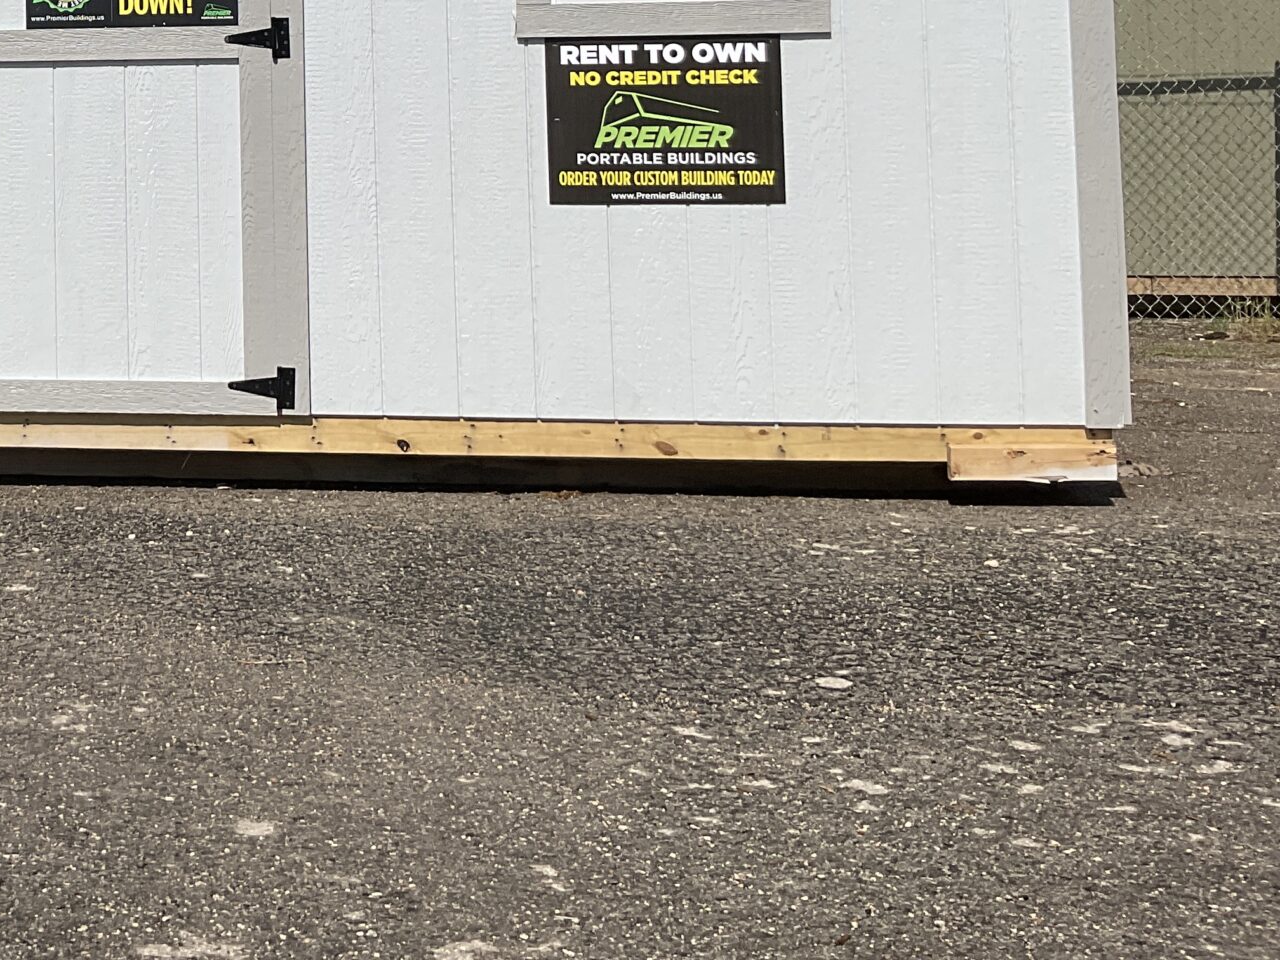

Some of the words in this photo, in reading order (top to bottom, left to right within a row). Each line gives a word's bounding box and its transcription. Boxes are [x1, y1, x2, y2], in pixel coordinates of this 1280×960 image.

[559, 44, 638, 65] RENT
[644, 43, 685, 63] TO
[691, 42, 766, 63] OWN
[570, 71, 601, 86] NO
[605, 70, 681, 86] CREDIT
[685, 69, 759, 84] CHECK
[593, 125, 734, 149] PREMIER
[576, 152, 663, 165] PORTABLE
[667, 152, 756, 164] BUILDINGS
[559, 171, 597, 186] ORDER
[600, 171, 630, 186] YOUR
[633, 171, 678, 186] CUSTOM
[681, 171, 735, 185] BUILDING
[738, 170, 775, 185] TODAY
[611, 192, 722, 200] www.PremierBuildings.us
